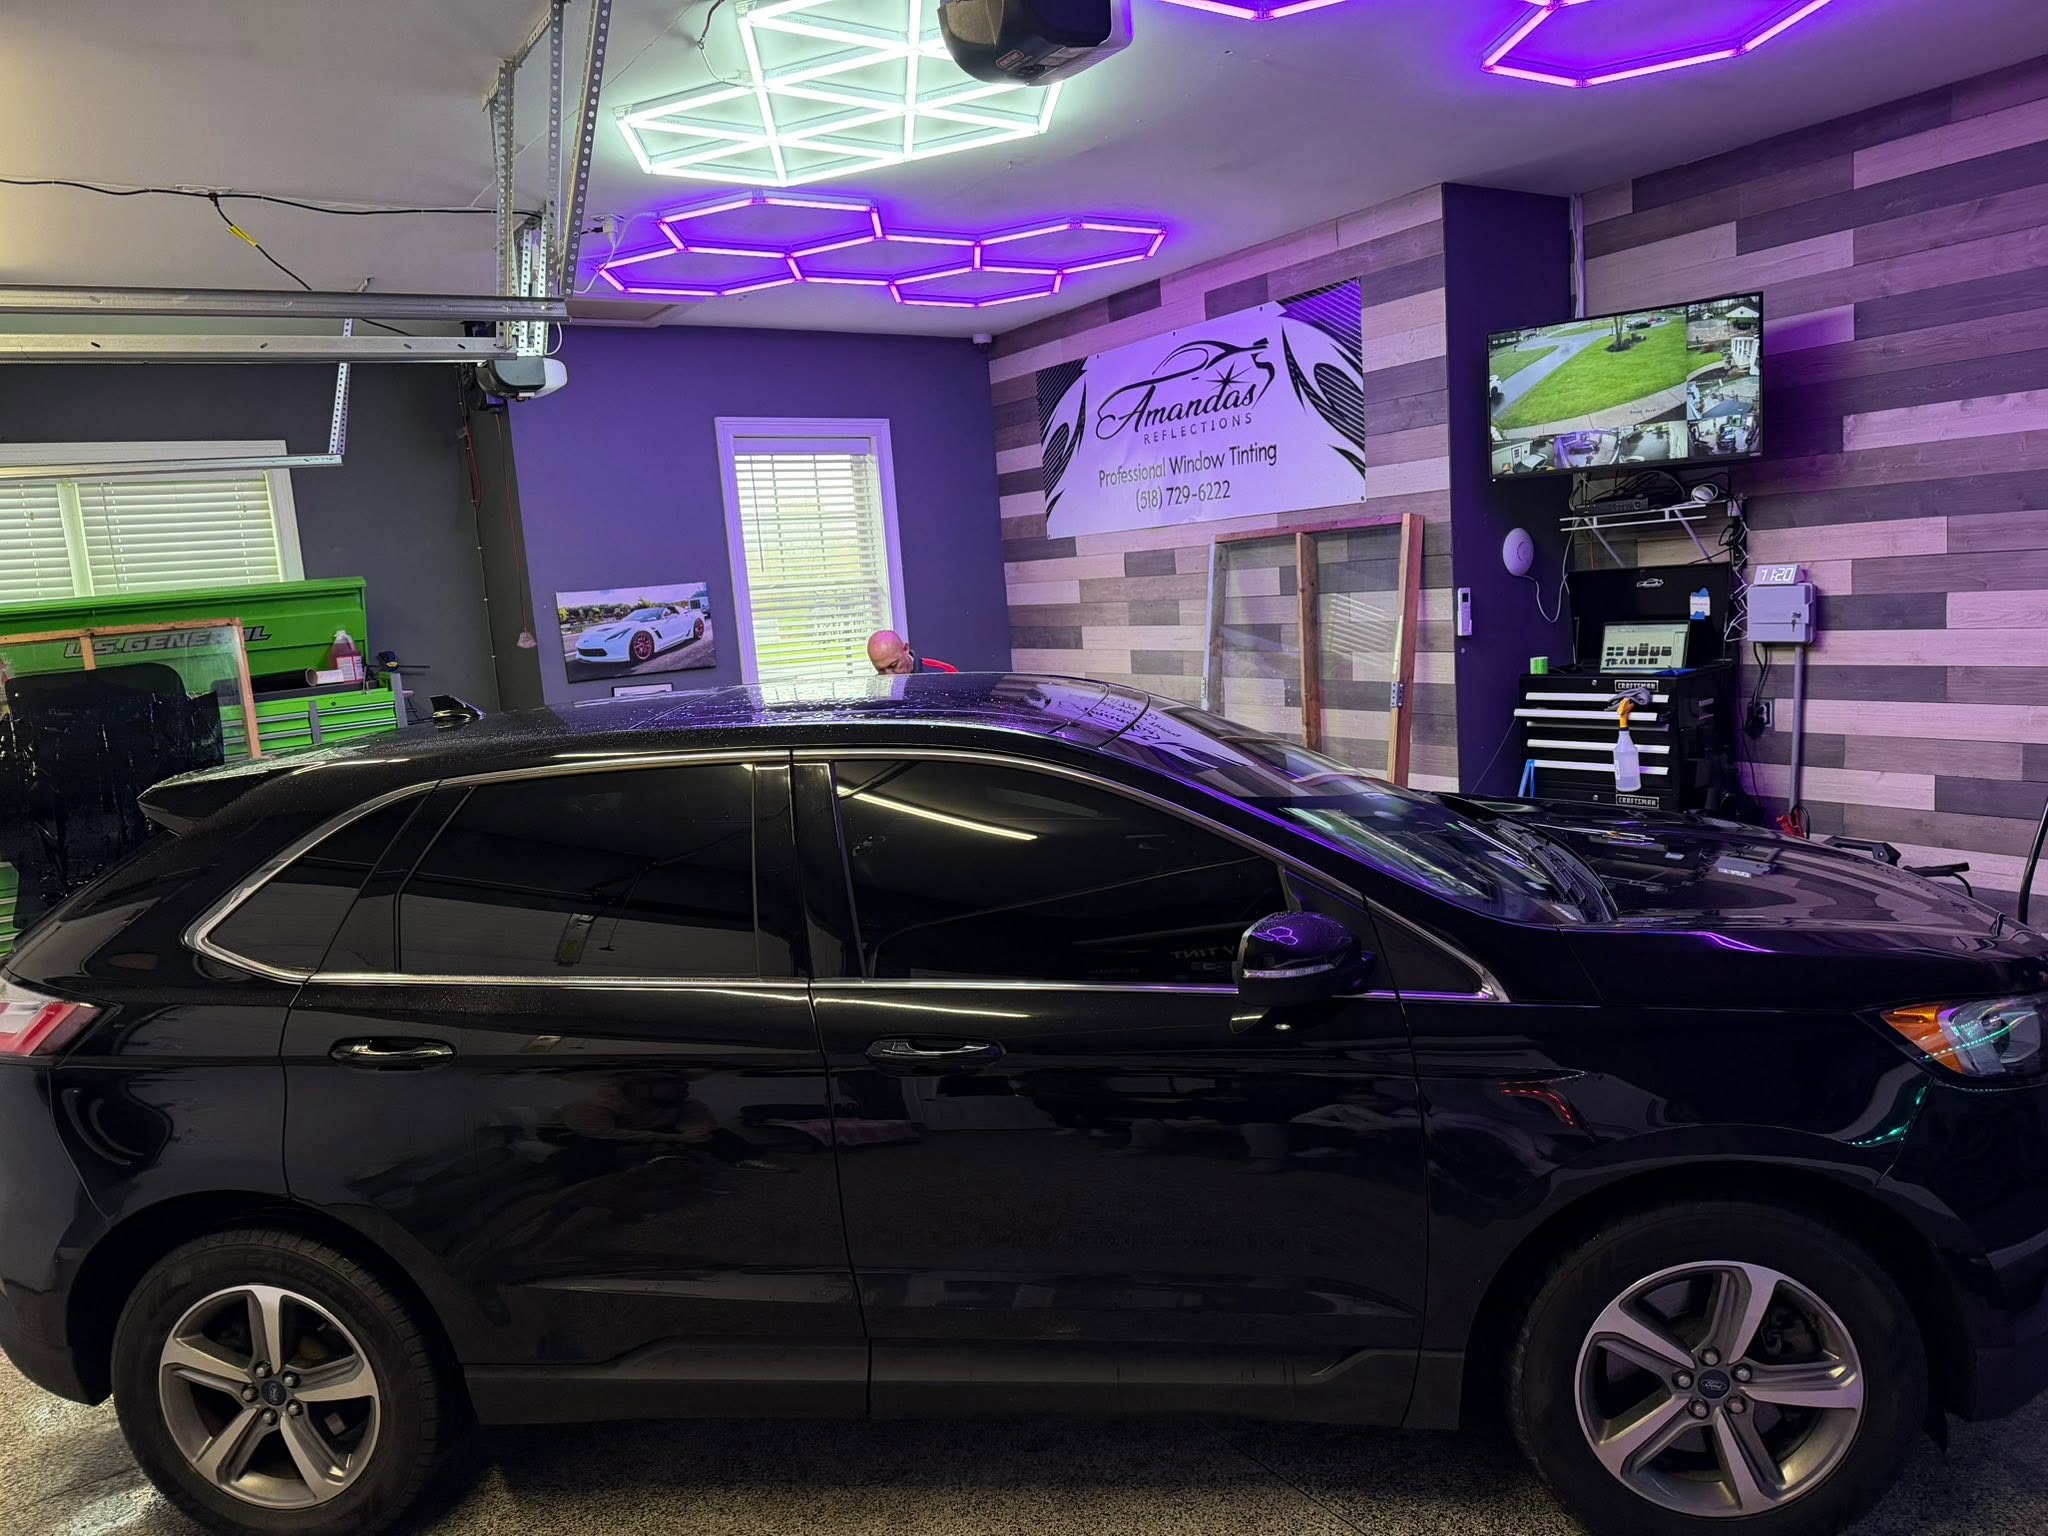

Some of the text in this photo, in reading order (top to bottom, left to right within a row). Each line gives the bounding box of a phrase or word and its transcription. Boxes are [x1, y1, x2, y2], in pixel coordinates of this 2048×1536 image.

[1096, 378, 1257, 440] Amandas
[1143, 412, 1253, 445] REFLECTIONS
[1099, 442, 1278, 488] Professional Window Tinting
[1135, 480, 1231, 513] (518) 729-6222
[1760, 567, 1795, 582] 11:20
